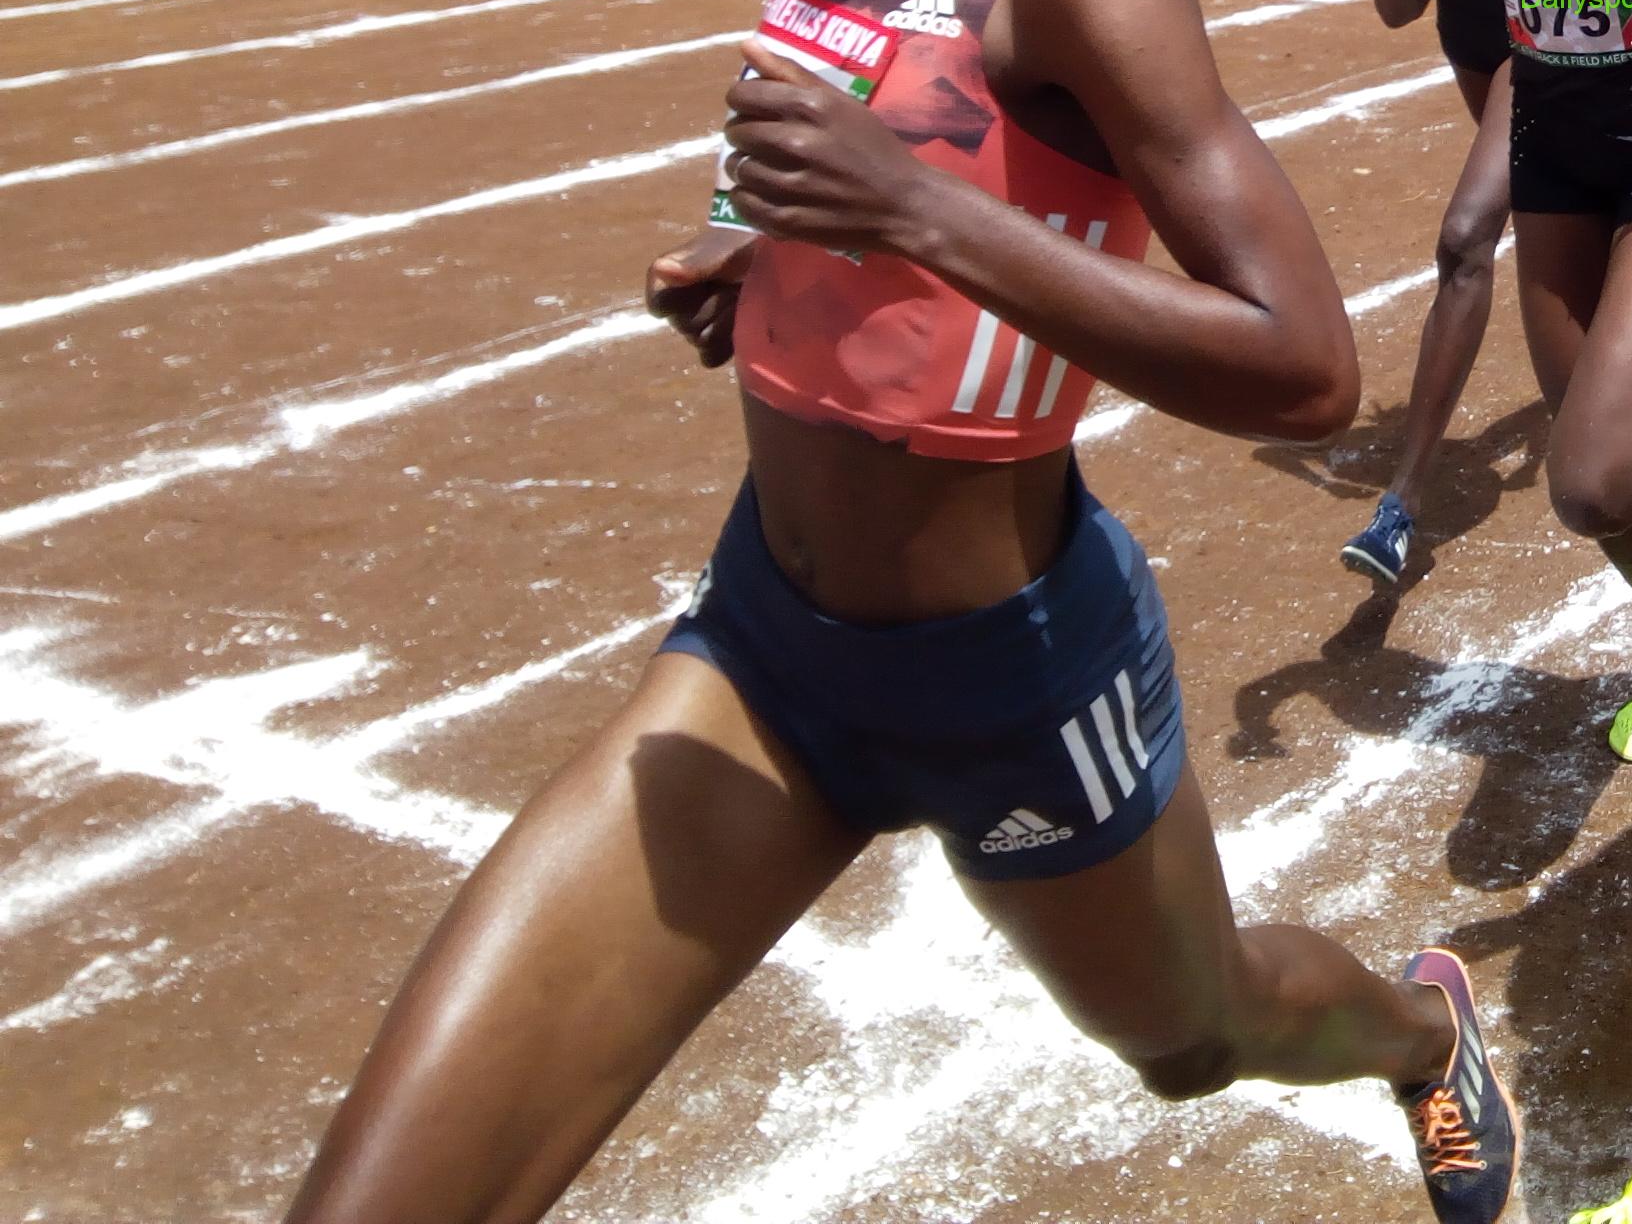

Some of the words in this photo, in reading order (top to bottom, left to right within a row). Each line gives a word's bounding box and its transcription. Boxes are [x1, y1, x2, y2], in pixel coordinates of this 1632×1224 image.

[882, 9, 964, 39] adidas
[816, 15, 888, 67] KENYA
[1571, 56, 1600, 66] FIELD
[1603, 53, 1632, 64] MEET
[979, 826, 1075, 853] adidas
